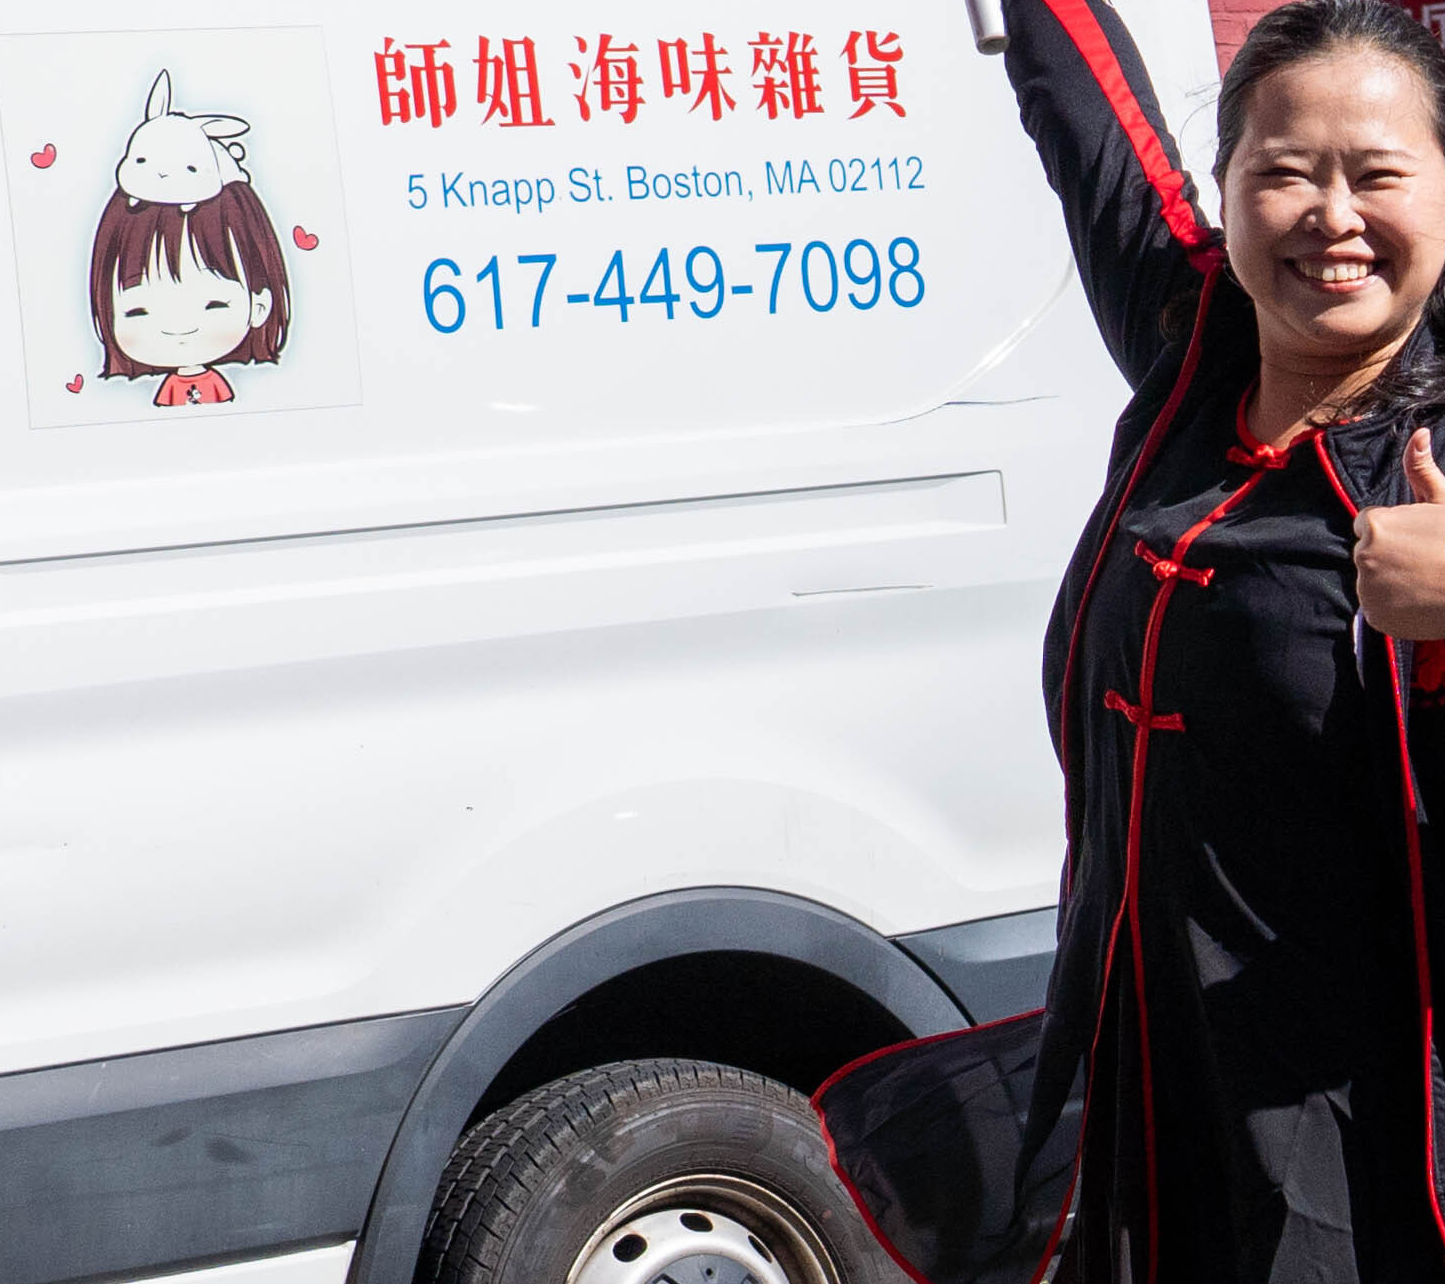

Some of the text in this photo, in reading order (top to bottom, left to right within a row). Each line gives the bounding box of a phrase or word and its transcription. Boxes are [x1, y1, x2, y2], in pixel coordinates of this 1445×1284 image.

[372, 28, 909, 129] 師姐海味雜貨
[407, 154, 926, 214] 5 Knapp St. Boston, MA 02112
[422, 236, 927, 335] 617-449-7098
